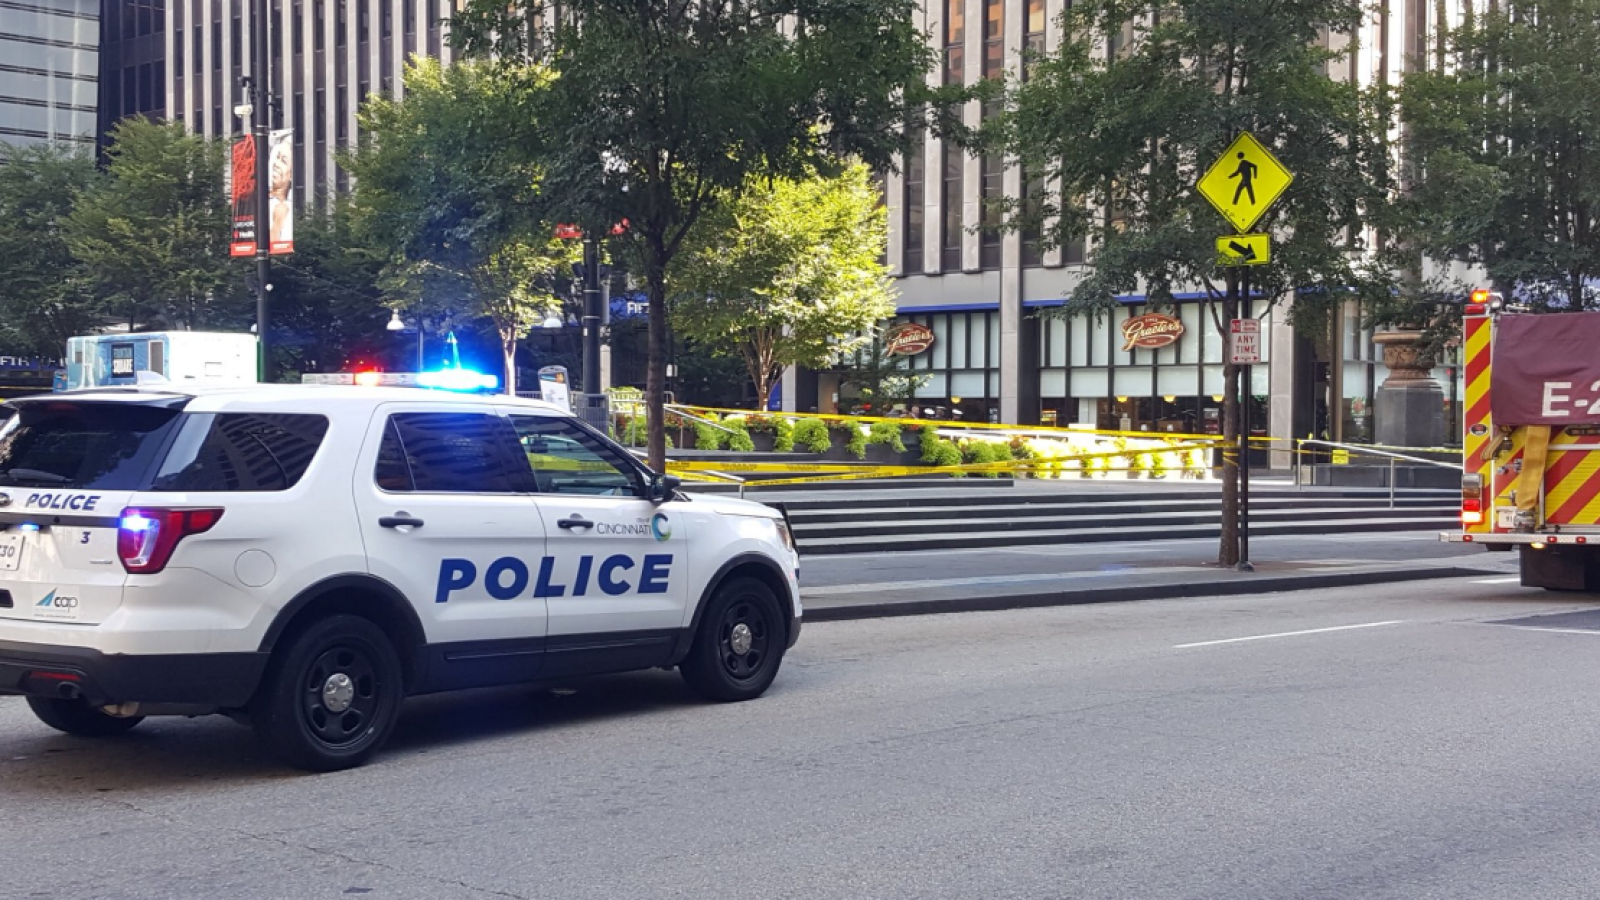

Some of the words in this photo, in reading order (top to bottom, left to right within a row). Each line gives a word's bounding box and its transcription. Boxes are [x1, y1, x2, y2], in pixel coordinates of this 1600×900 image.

[1237, 335, 1255, 344] ANY
[1235, 345, 1257, 354] TIME
[25, 493, 102, 511] POLICE
[597, 522, 652, 535] CINCINNATI
[80, 531, 92, 544] 3
[435, 554, 674, 603] POLICE
[54, 596, 78, 613] cap
